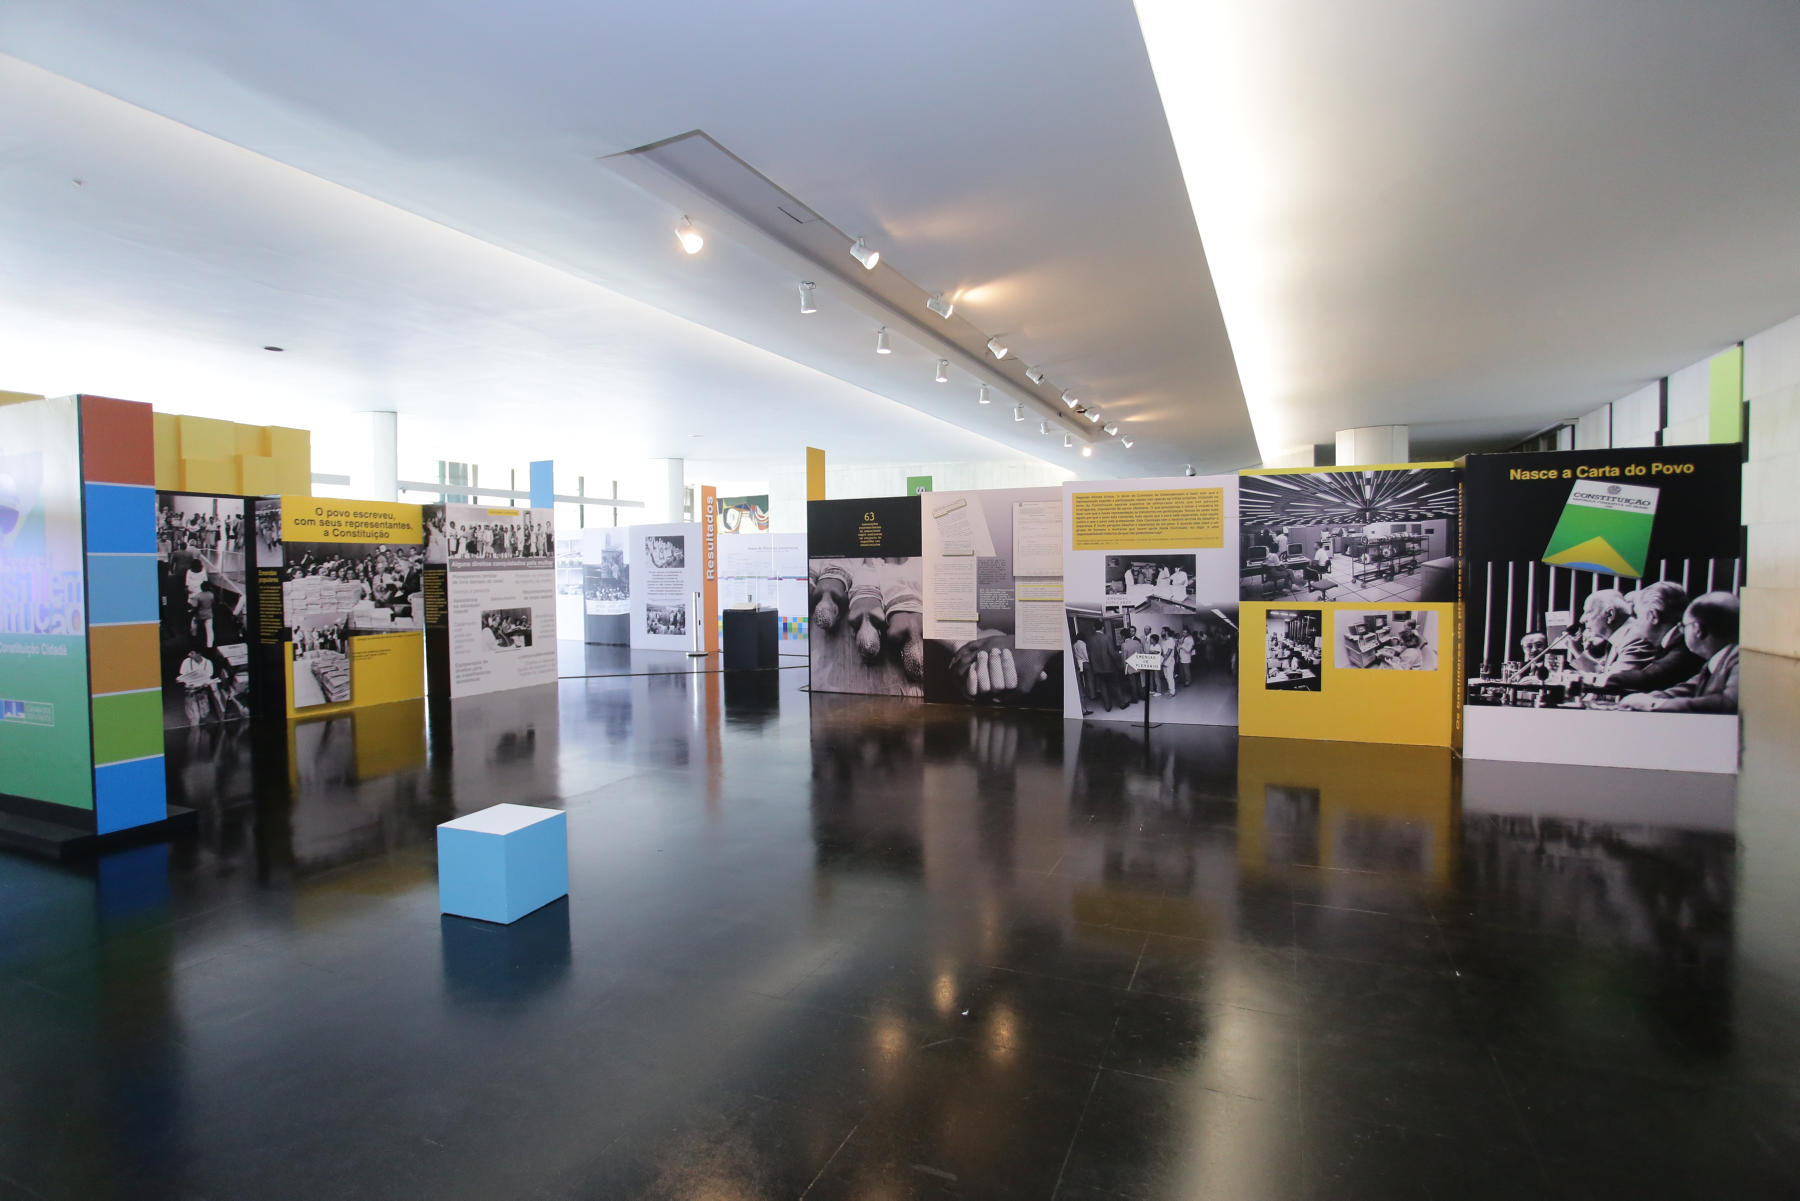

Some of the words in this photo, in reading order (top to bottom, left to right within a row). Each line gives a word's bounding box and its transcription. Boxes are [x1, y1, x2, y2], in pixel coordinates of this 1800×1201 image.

[1509, 468, 1558, 480] Nasce
[1562, 469, 1572, 478] a
[1576, 466, 1620, 478] Carta
[1625, 464, 1646, 476] do
[1651, 462, 1695, 475] Povo
[315, 507, 324, 517] O
[326, 509, 351, 519] povo
[353, 511, 396, 521] escreveu,
[864, 511, 875, 521] 63
[294, 518, 316, 526] com
[319, 519, 342, 527] seus
[332, 528, 390, 540] Constituição
[706, 496, 715, 581] Resultados
